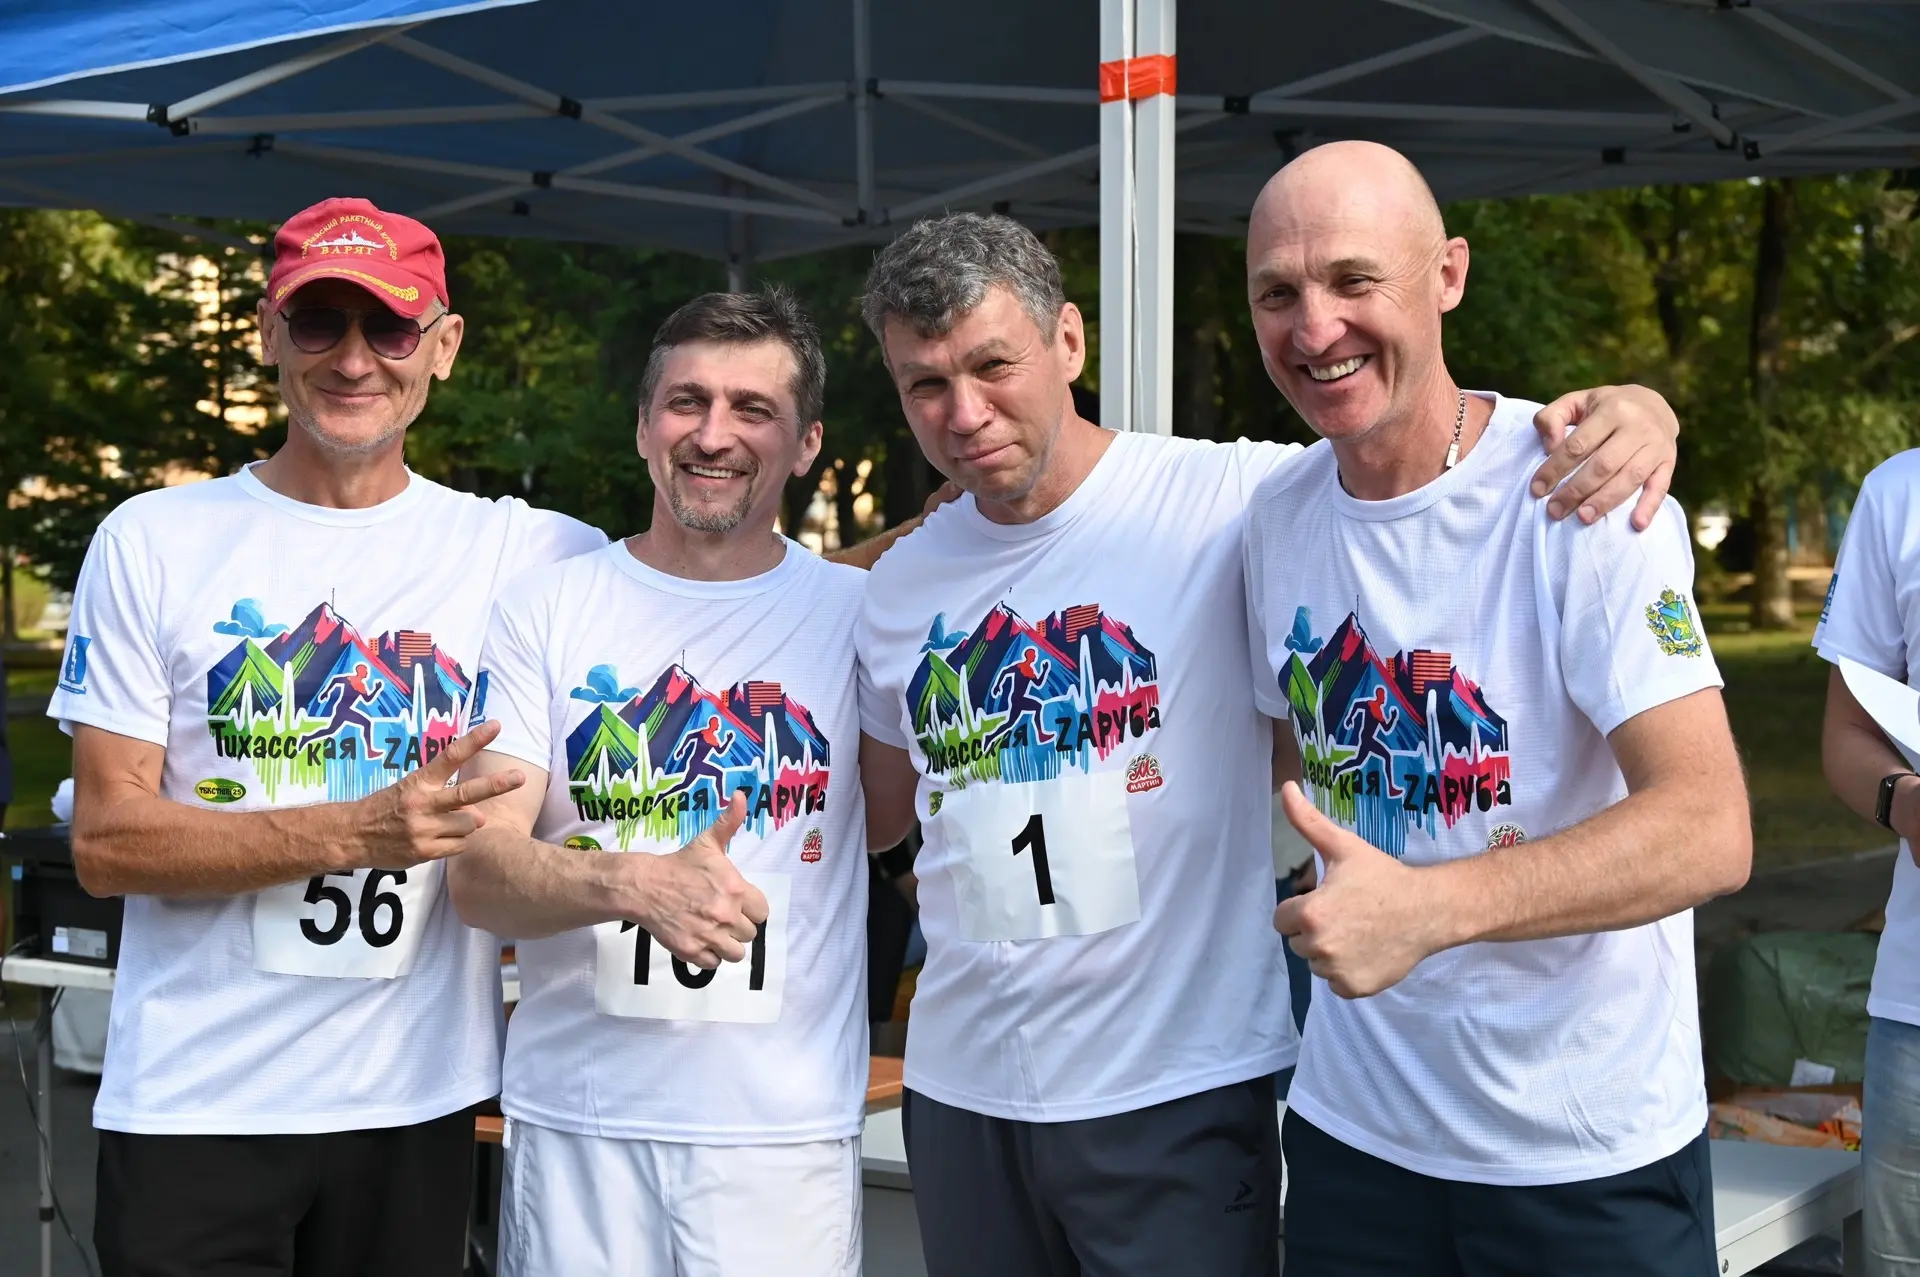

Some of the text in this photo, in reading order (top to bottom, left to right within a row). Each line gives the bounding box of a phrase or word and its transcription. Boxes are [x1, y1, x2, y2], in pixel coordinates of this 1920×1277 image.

[340, 214, 384, 233] РАКЕТНЫЙ
[320, 245, 376, 255] ВАРЯГ
[1130, 778, 1161, 791] МАРТИН
[1011, 813, 1056, 906] 1
[299, 867, 408, 948] 56
